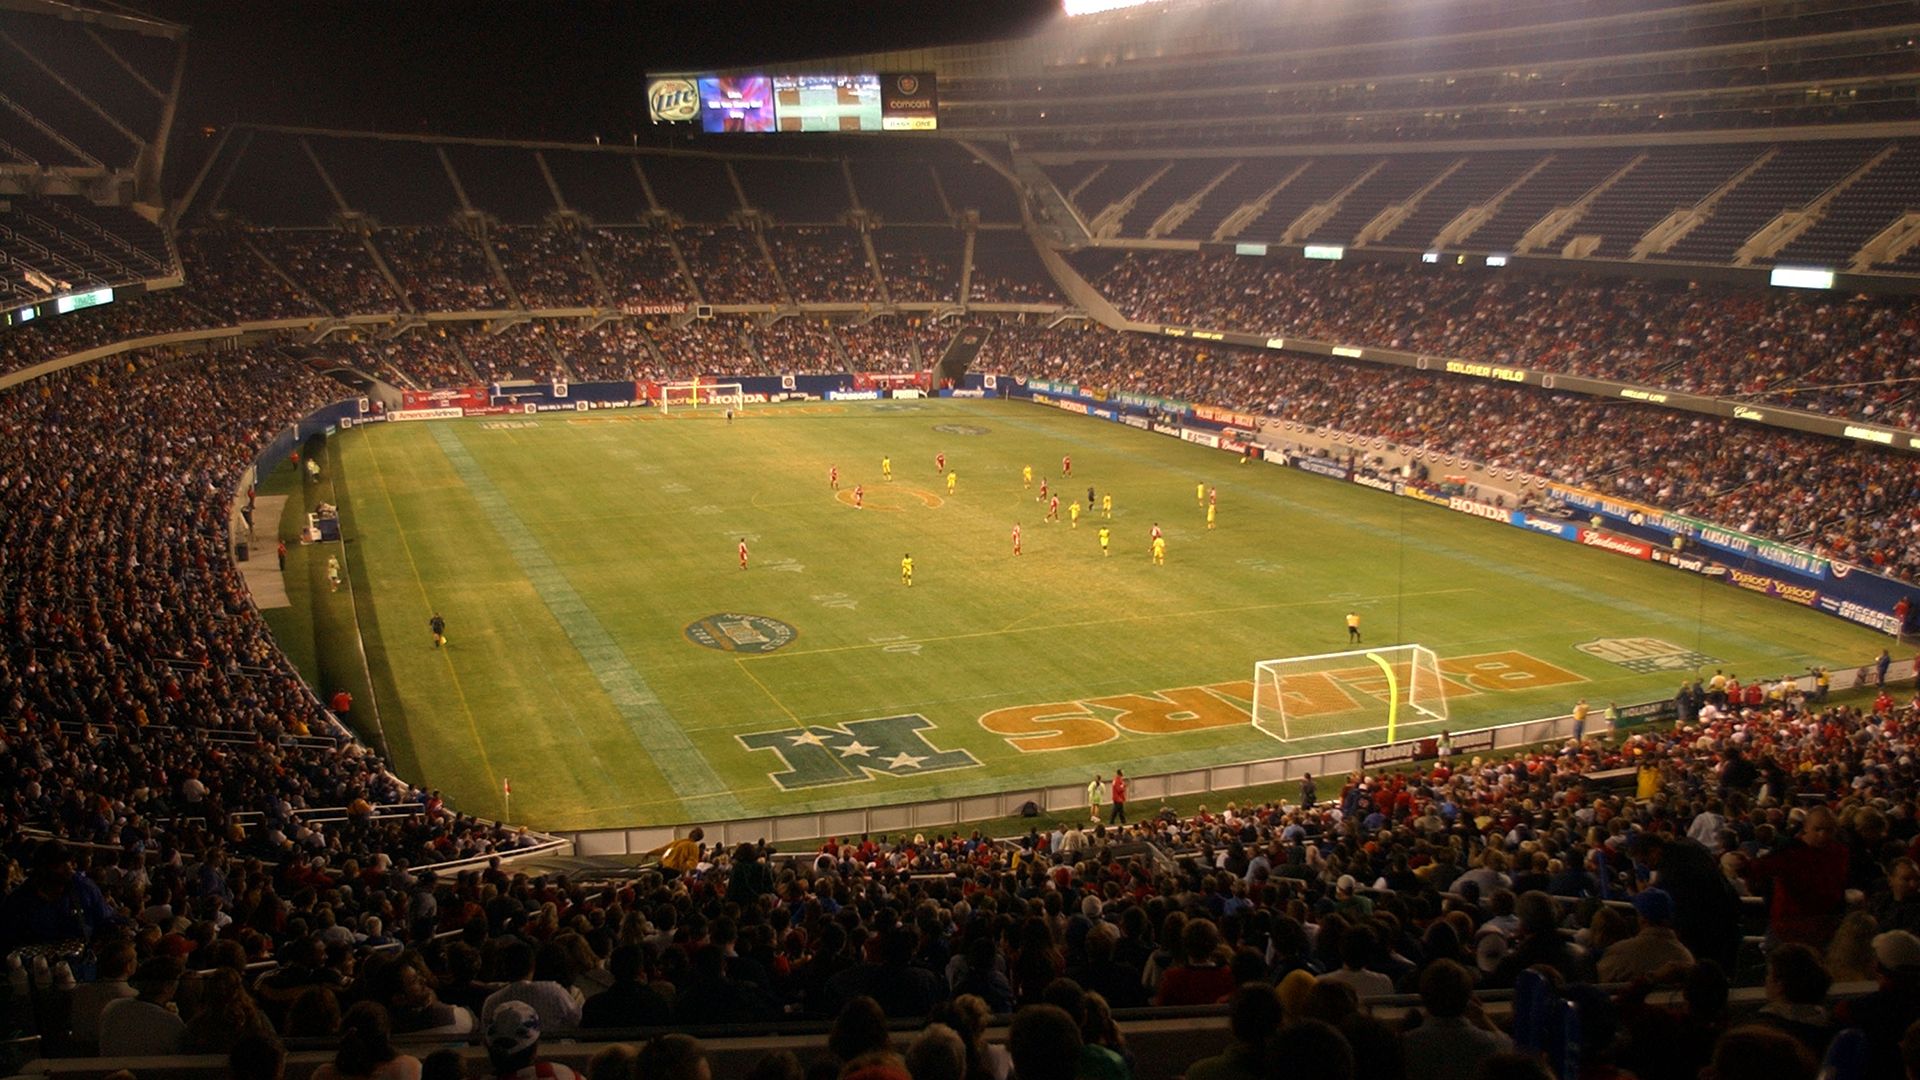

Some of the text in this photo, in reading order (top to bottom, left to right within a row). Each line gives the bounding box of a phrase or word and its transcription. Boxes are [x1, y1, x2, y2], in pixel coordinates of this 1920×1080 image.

[656, 89, 697, 112] Lite
[890, 99, 931, 109] comcast
[644, 304, 686, 314] NOWAK
[1446, 361, 1524, 382] SOLDIER FIELD
[709, 393, 767, 404] HONDA
[830, 391, 878, 400] Panasonic
[1450, 498, 1511, 523] HONDA
[1583, 530, 1643, 555] Budweiser
[1701, 528, 1750, 552] KANSAS CITY
[1679, 557, 1702, 572] you?
[1758, 544, 1808, 571] WASHINGTON
[1838, 607, 1884, 629] SATURDAY
[1842, 600, 1887, 620] SOCCER
